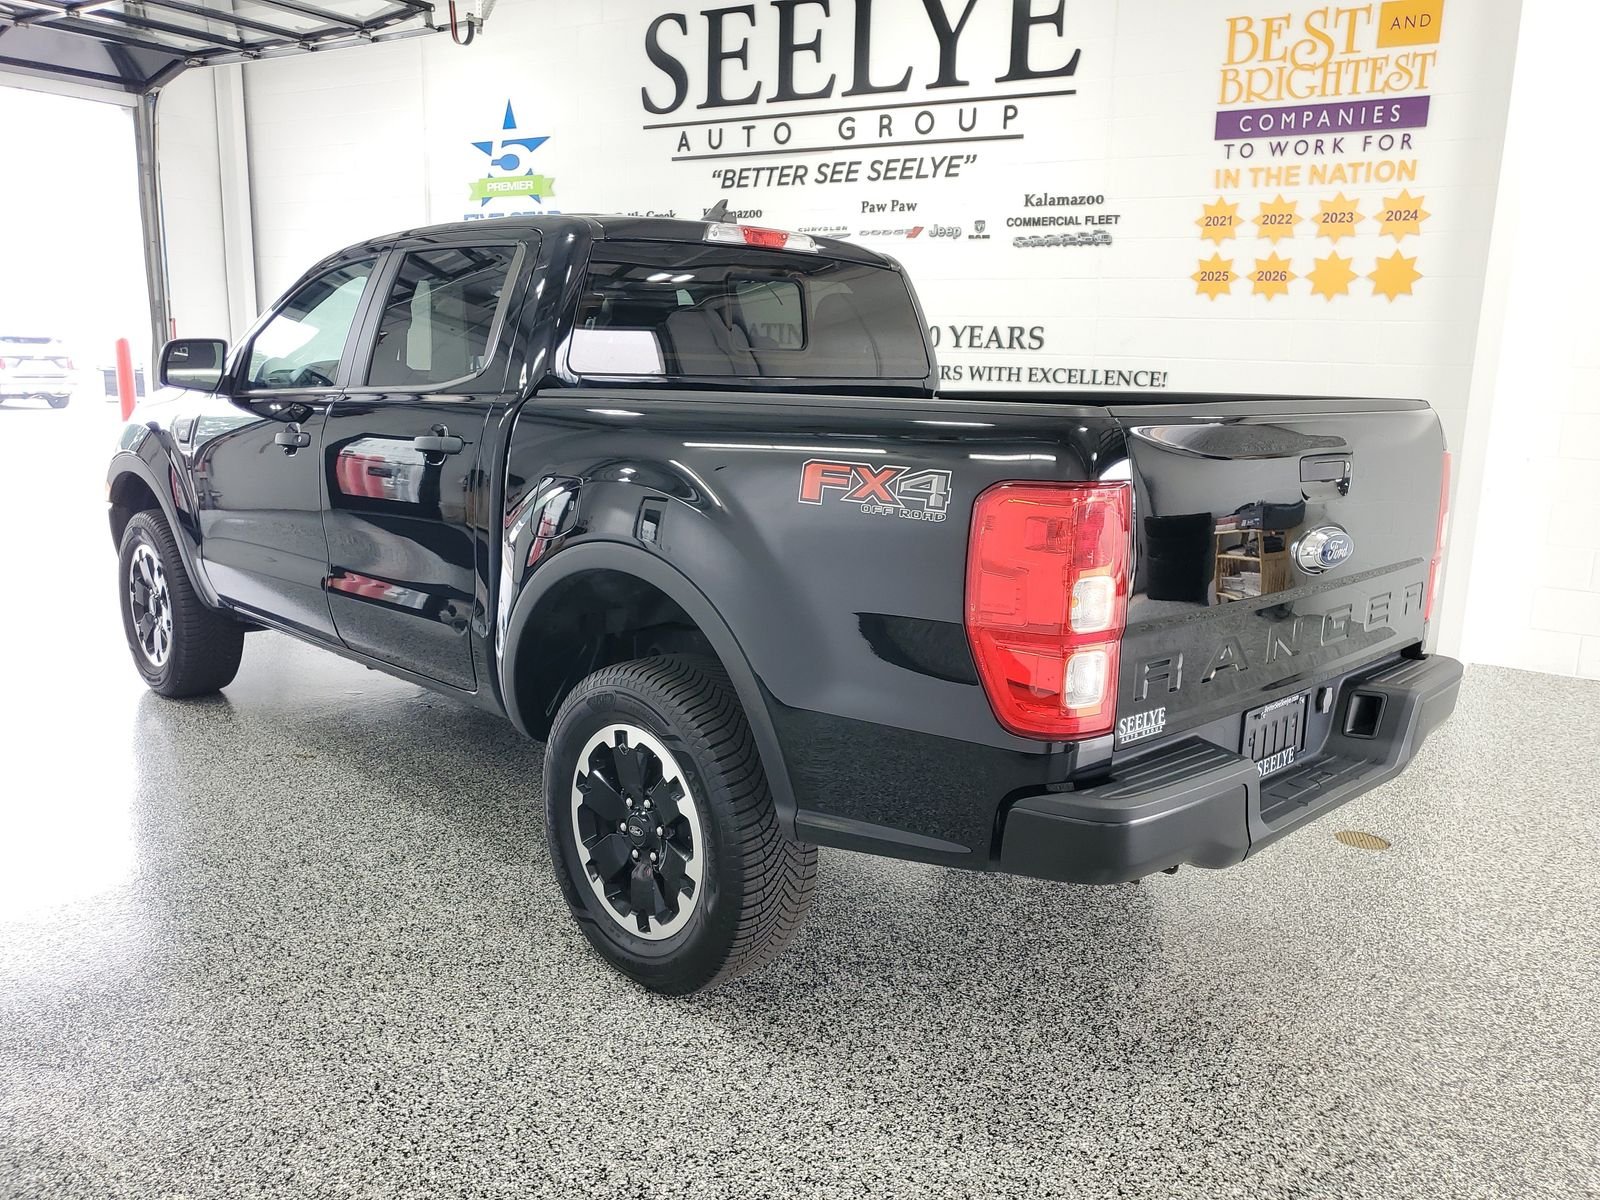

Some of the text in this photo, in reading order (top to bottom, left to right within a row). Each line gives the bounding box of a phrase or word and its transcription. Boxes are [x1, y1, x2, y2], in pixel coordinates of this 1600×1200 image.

[1222, 4, 1432, 71] BEST AND
[641, 0, 1081, 114] SEELYE
[1217, 50, 1438, 105] BRIGHTEST
[677, 105, 1018, 152] AUTO GROUP
[1239, 104, 1401, 132] COMPANIES
[1224, 133, 1412, 159] TO WORK FOR
[712, 154, 977, 189] “BETTER SEE SEELYE”
[1215, 160, 1417, 189] IN THE NATION
[487, 180, 534, 192] PREMIER
[861, 200, 917, 213] Paw Paw
[1024, 193, 1104, 208] Kalamazoo
[1006, 214, 1120, 227] COMMERCIAL FLEET
[1205, 216, 1233, 226] 2021
[1262, 214, 1292, 225] 2022
[1322, 212, 1354, 223] 2023
[1385, 210, 1418, 222] 2024
[928, 224, 962, 239] Jeep
[1200, 271, 1229, 282] 2025
[1257, 271, 1287, 282] 2026
[949, 325, 1045, 350] YEARS
[968, 366, 1022, 383] WITH
[1028, 367, 1168, 388] EXCELLENCE!
[798, 458, 952, 513] FX4
[860, 504, 946, 522] OFF ROAD
[1134, 582, 1424, 702] RANGER
[1119, 707, 1166, 735] SEELYE
[1257, 746, 1296, 777] SEELYE
